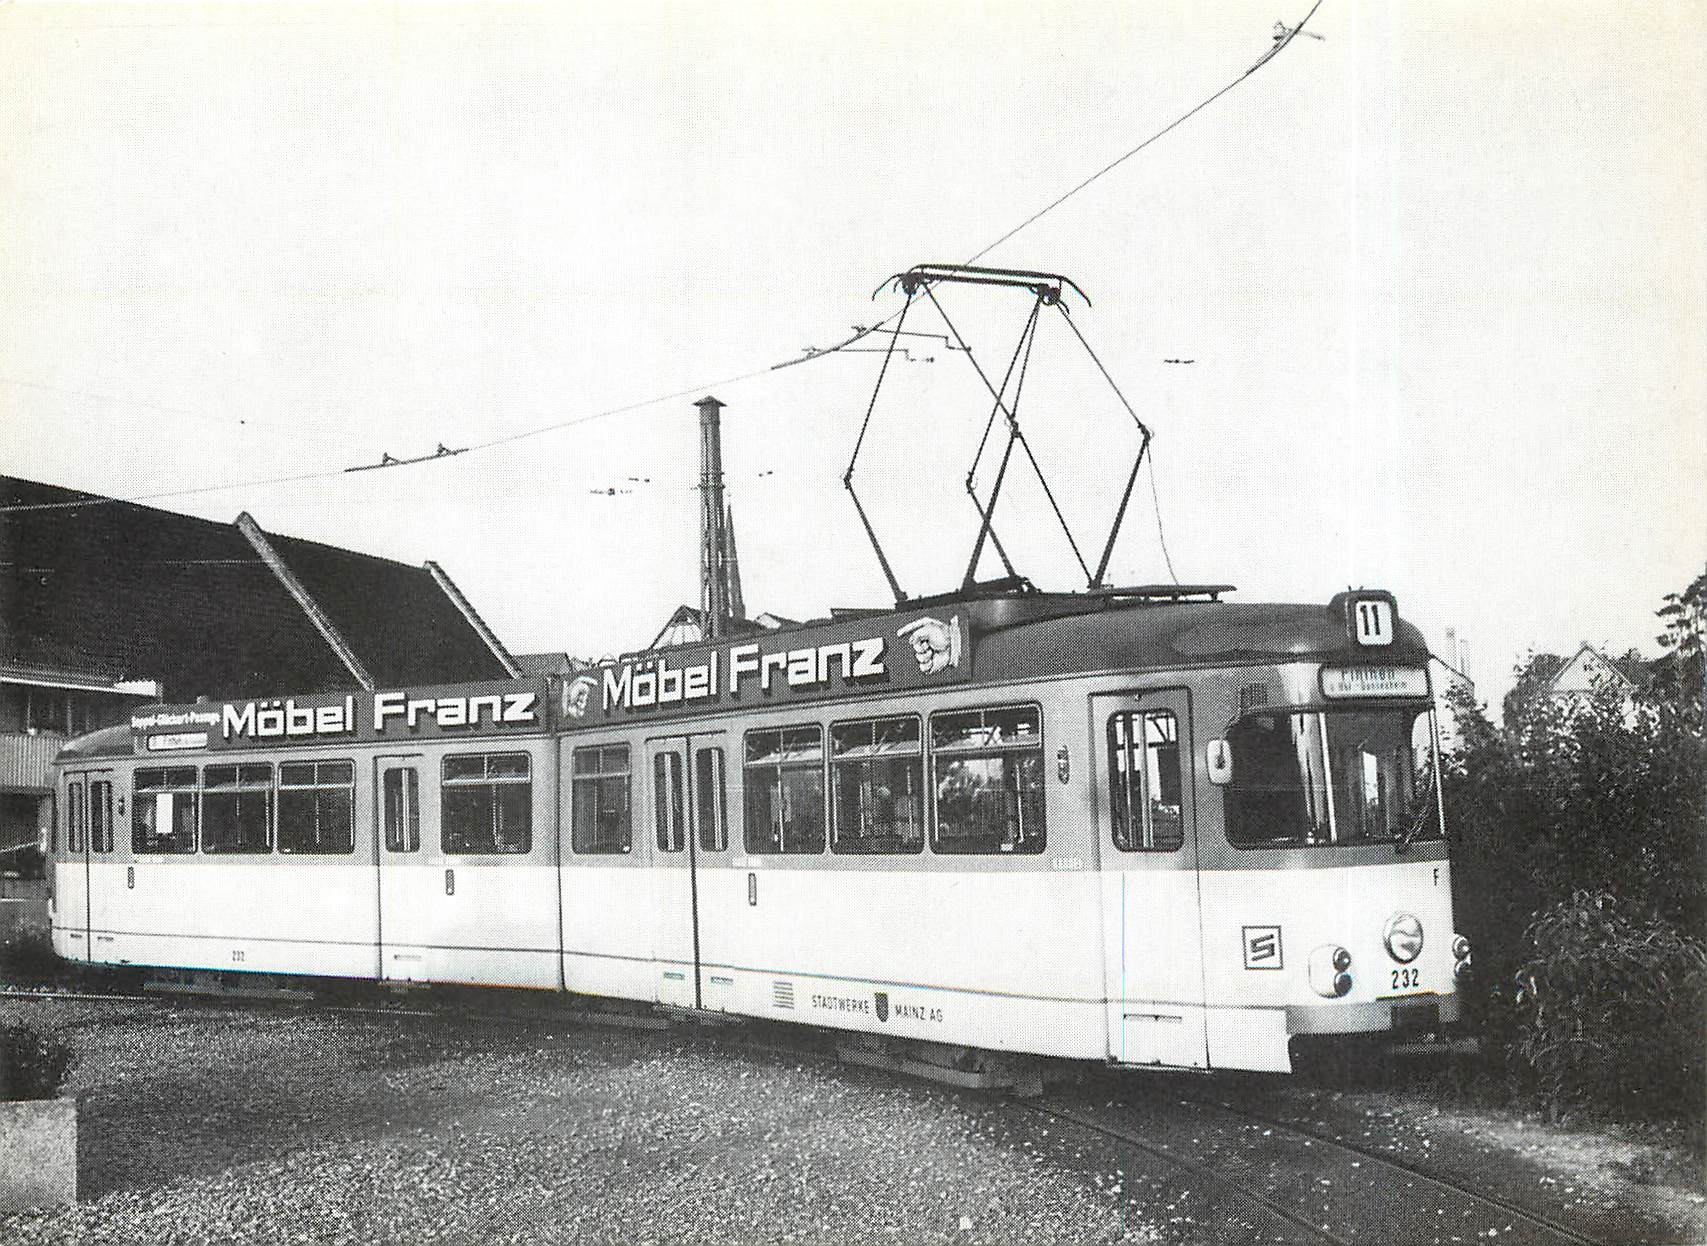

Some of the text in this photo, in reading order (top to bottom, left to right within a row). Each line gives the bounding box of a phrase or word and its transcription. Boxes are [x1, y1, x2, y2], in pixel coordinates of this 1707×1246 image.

[1359, 604, 1381, 636] 11
[603, 637, 884, 709] Möbel Franz
[222, 691, 536, 739] Möbel Franz
[1433, 868, 1440, 886] F
[231, 950, 245, 962] 232
[1391, 968, 1419, 990] 232
[811, 994, 943, 1023] STADTWERKE MAINZ AG
